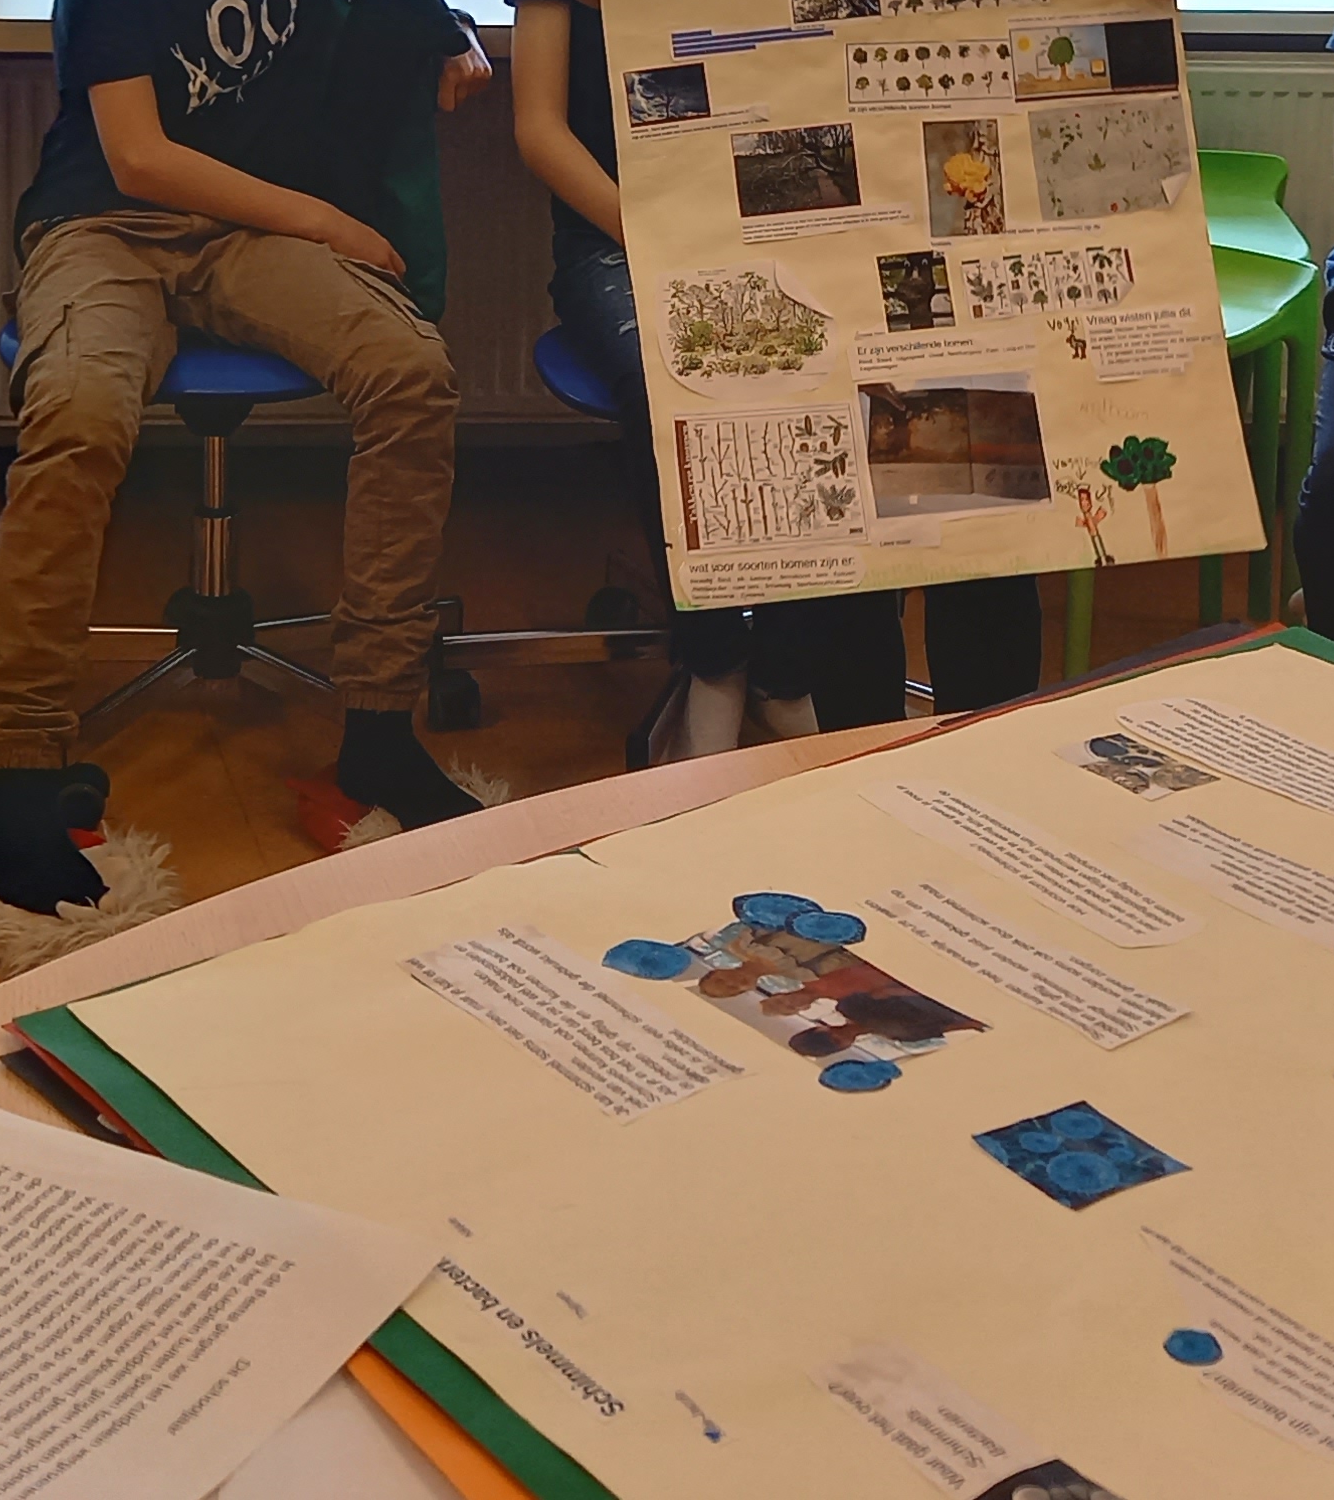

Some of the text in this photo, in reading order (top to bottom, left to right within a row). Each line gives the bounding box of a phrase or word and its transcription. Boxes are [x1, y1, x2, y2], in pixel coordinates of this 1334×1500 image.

[688, 563, 709, 574] wat
[710, 561, 735, 573] voor
[737, 559, 778, 573] soorten
[779, 557, 818, 570] bomen
[819, 556, 840, 571] zijn
[496, 1307, 525, 1330] en
[520, 1327, 624, 1418] Schimmels
